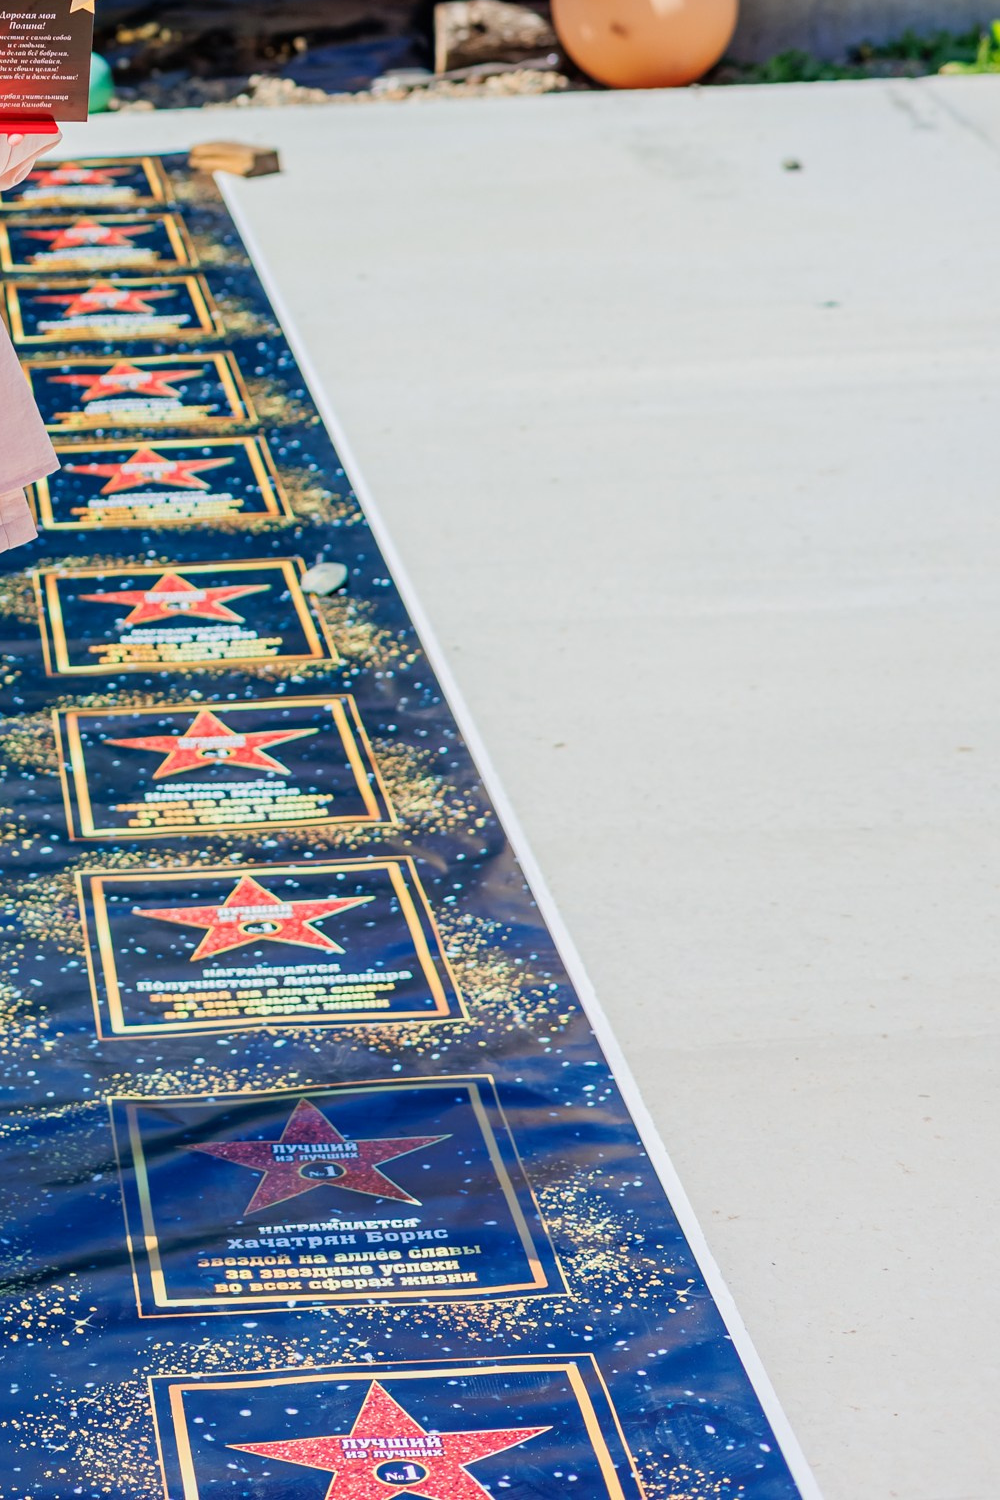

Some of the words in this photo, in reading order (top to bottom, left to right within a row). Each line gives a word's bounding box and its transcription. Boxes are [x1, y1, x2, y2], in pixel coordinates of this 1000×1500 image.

[0, 11, 36, 20] Дорогая
[9, 21, 46, 30] Полина!
[272, 1142, 358, 1154] ЛУЧШИЙ
[299, 1152, 359, 1161] лучших
[258, 1218, 419, 1235] НАГРАЖДАЕТСЯ
[366, 1227, 449, 1243] Борис
[198, 1253, 291, 1267] звездой
[299, 1253, 328, 1264] на
[334, 1250, 402, 1262] аллее
[408, 1245, 481, 1259] славы
[225, 1269, 254, 1280] за
[260, 1265, 373, 1279] звездные
[379, 1259, 460, 1275] успехи
[215, 1282, 243, 1293] во
[250, 1281, 303, 1292] всех
[308, 1276, 395, 1291] сферах
[400, 1272, 478, 1286] жизни
[341, 1435, 442, 1450] ЛУЧШИЙ
[345, 1449, 368, 1458] из
[373, 1448, 444, 1459] лучших
